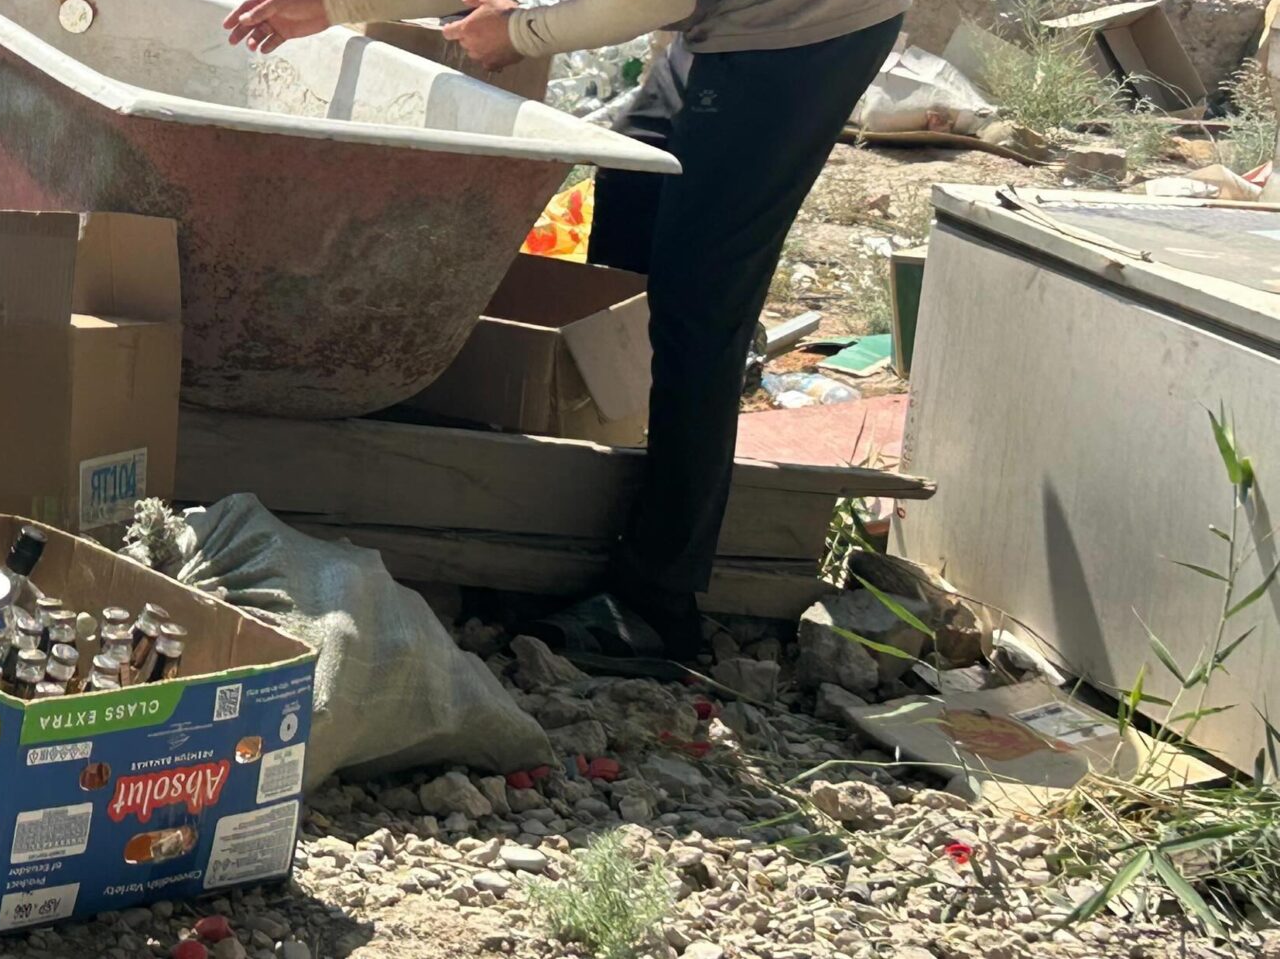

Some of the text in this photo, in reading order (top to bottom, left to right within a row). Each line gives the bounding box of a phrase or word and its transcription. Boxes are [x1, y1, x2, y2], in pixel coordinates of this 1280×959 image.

[39, 699, 160, 731] CLASS EXTRA
[111, 764, 225, 816] Absolut
